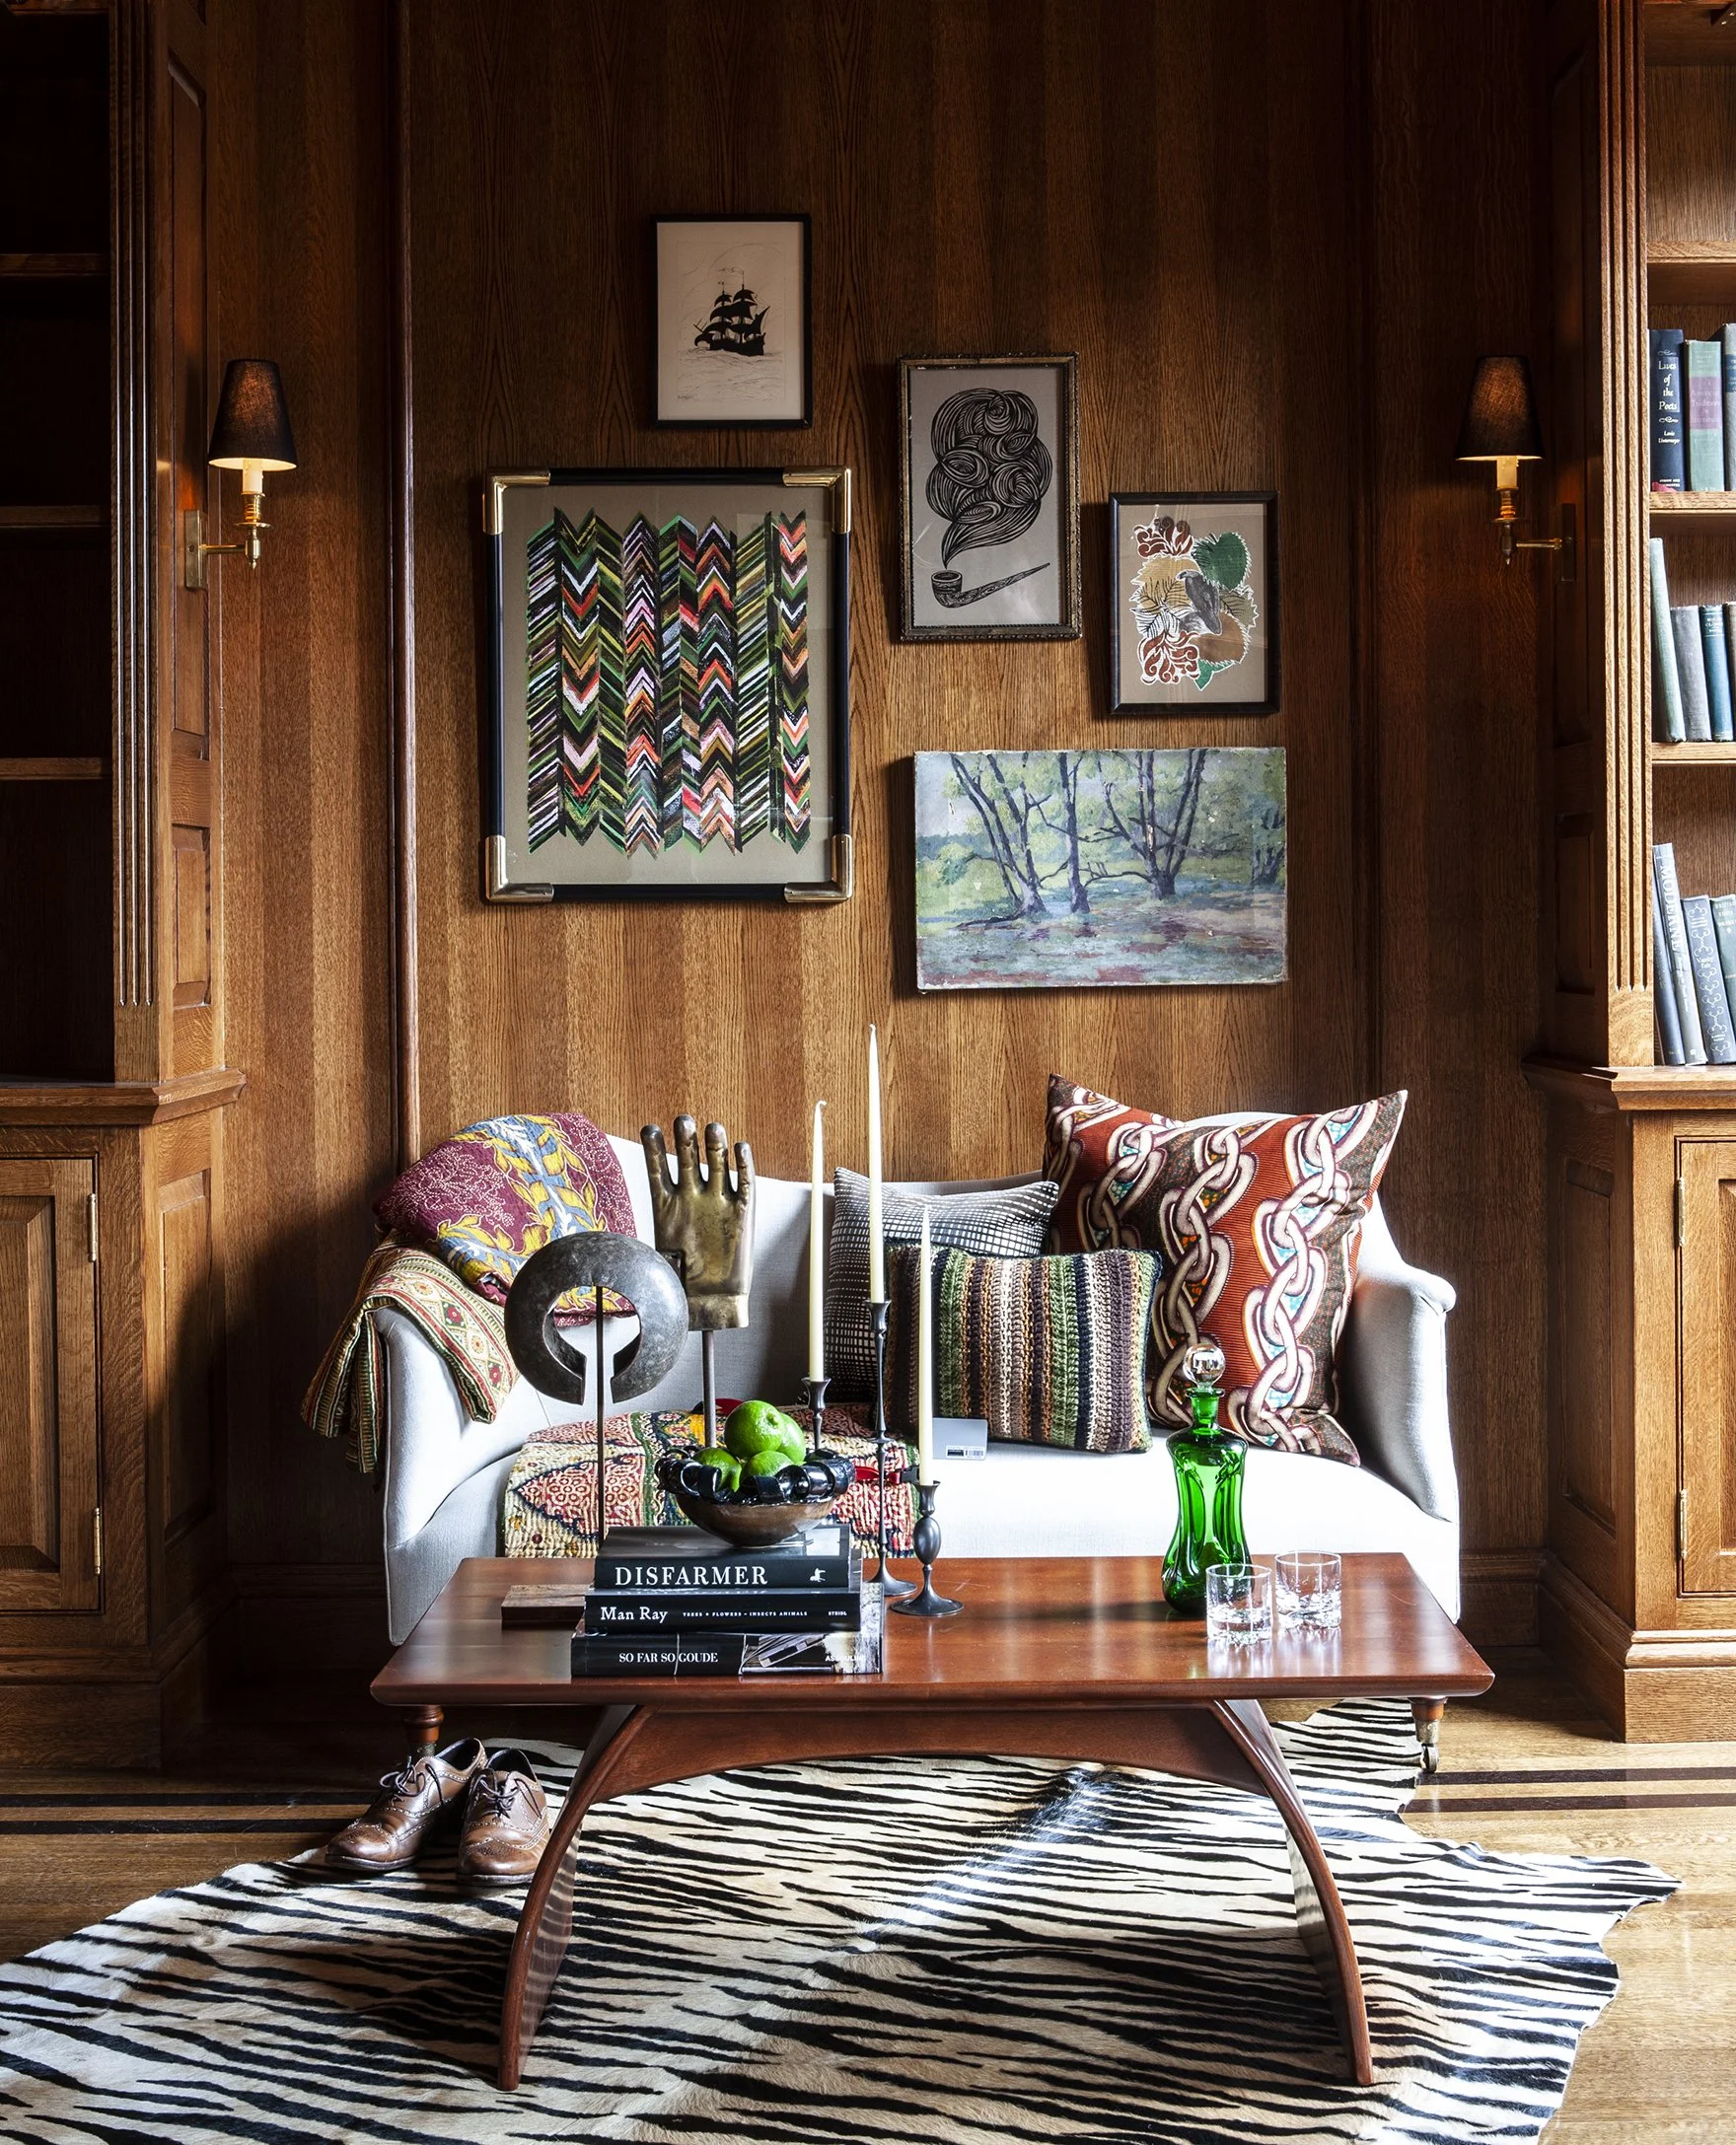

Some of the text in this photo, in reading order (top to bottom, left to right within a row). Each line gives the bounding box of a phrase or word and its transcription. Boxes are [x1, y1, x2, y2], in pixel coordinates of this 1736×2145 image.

[1658, 360, 1677, 370] Lives
[1663, 374, 1672, 387] of
[1663, 388, 1674, 396] the
[1658, 400, 1678, 410] Poets
[615, 1566, 768, 1586] DISFARMER
[600, 1607, 634, 1620] Man
[639, 1607, 668, 1623] Ray
[618, 1652, 634, 1663] SO
[637, 1652, 658, 1663] FAR
[660, 1652, 676, 1663] SO
[678, 1652, 719, 1663] GOUDE
